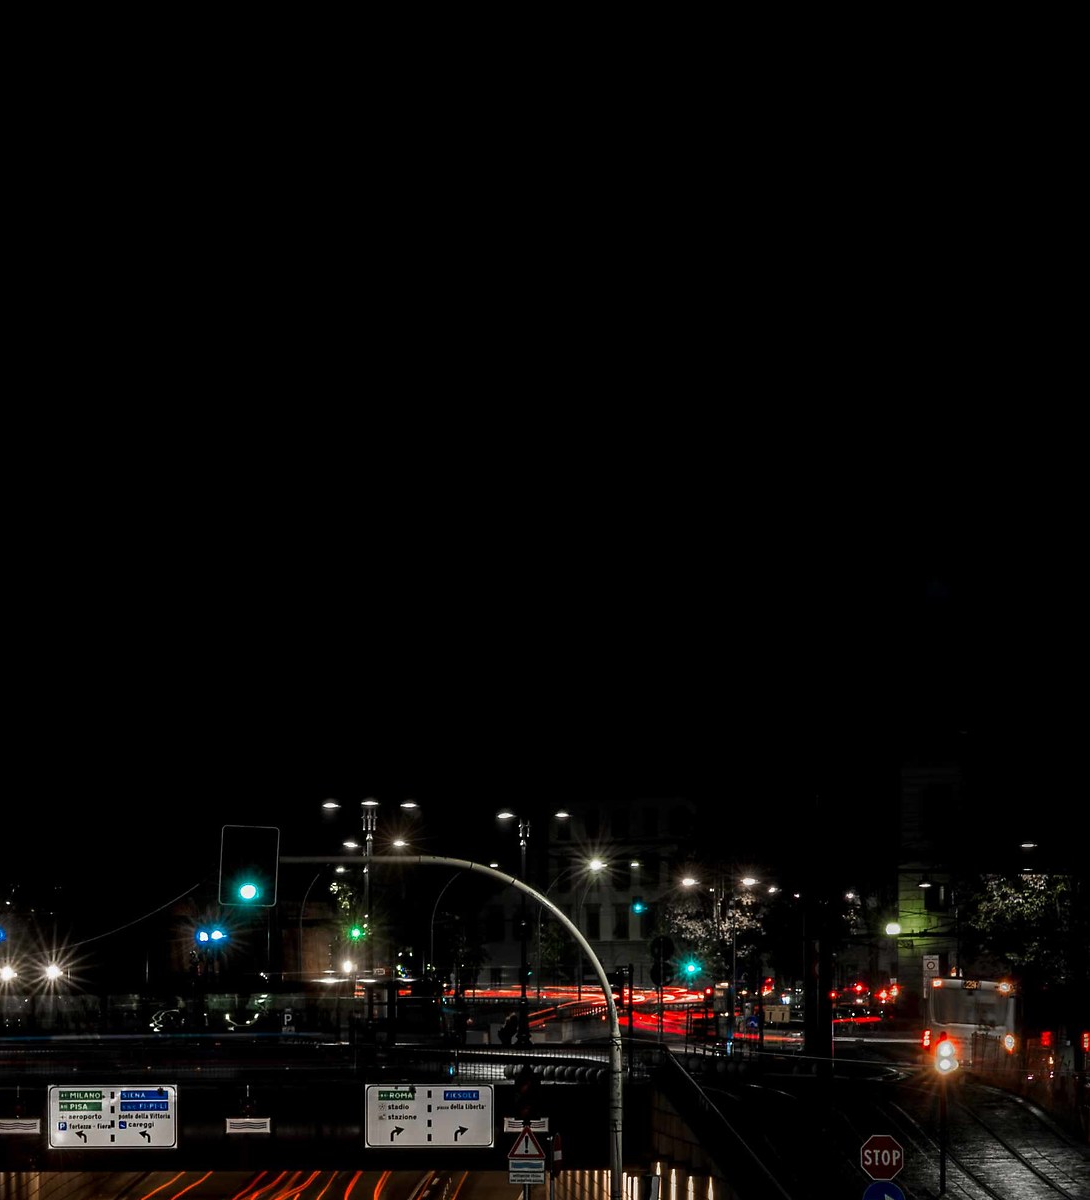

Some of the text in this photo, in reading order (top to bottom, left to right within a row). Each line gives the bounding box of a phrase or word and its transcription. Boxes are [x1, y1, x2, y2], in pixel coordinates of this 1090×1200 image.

[283, 1011, 293, 1026] P
[128, 1121, 154, 1129] careggi
[864, 1149, 901, 1166] STOP
